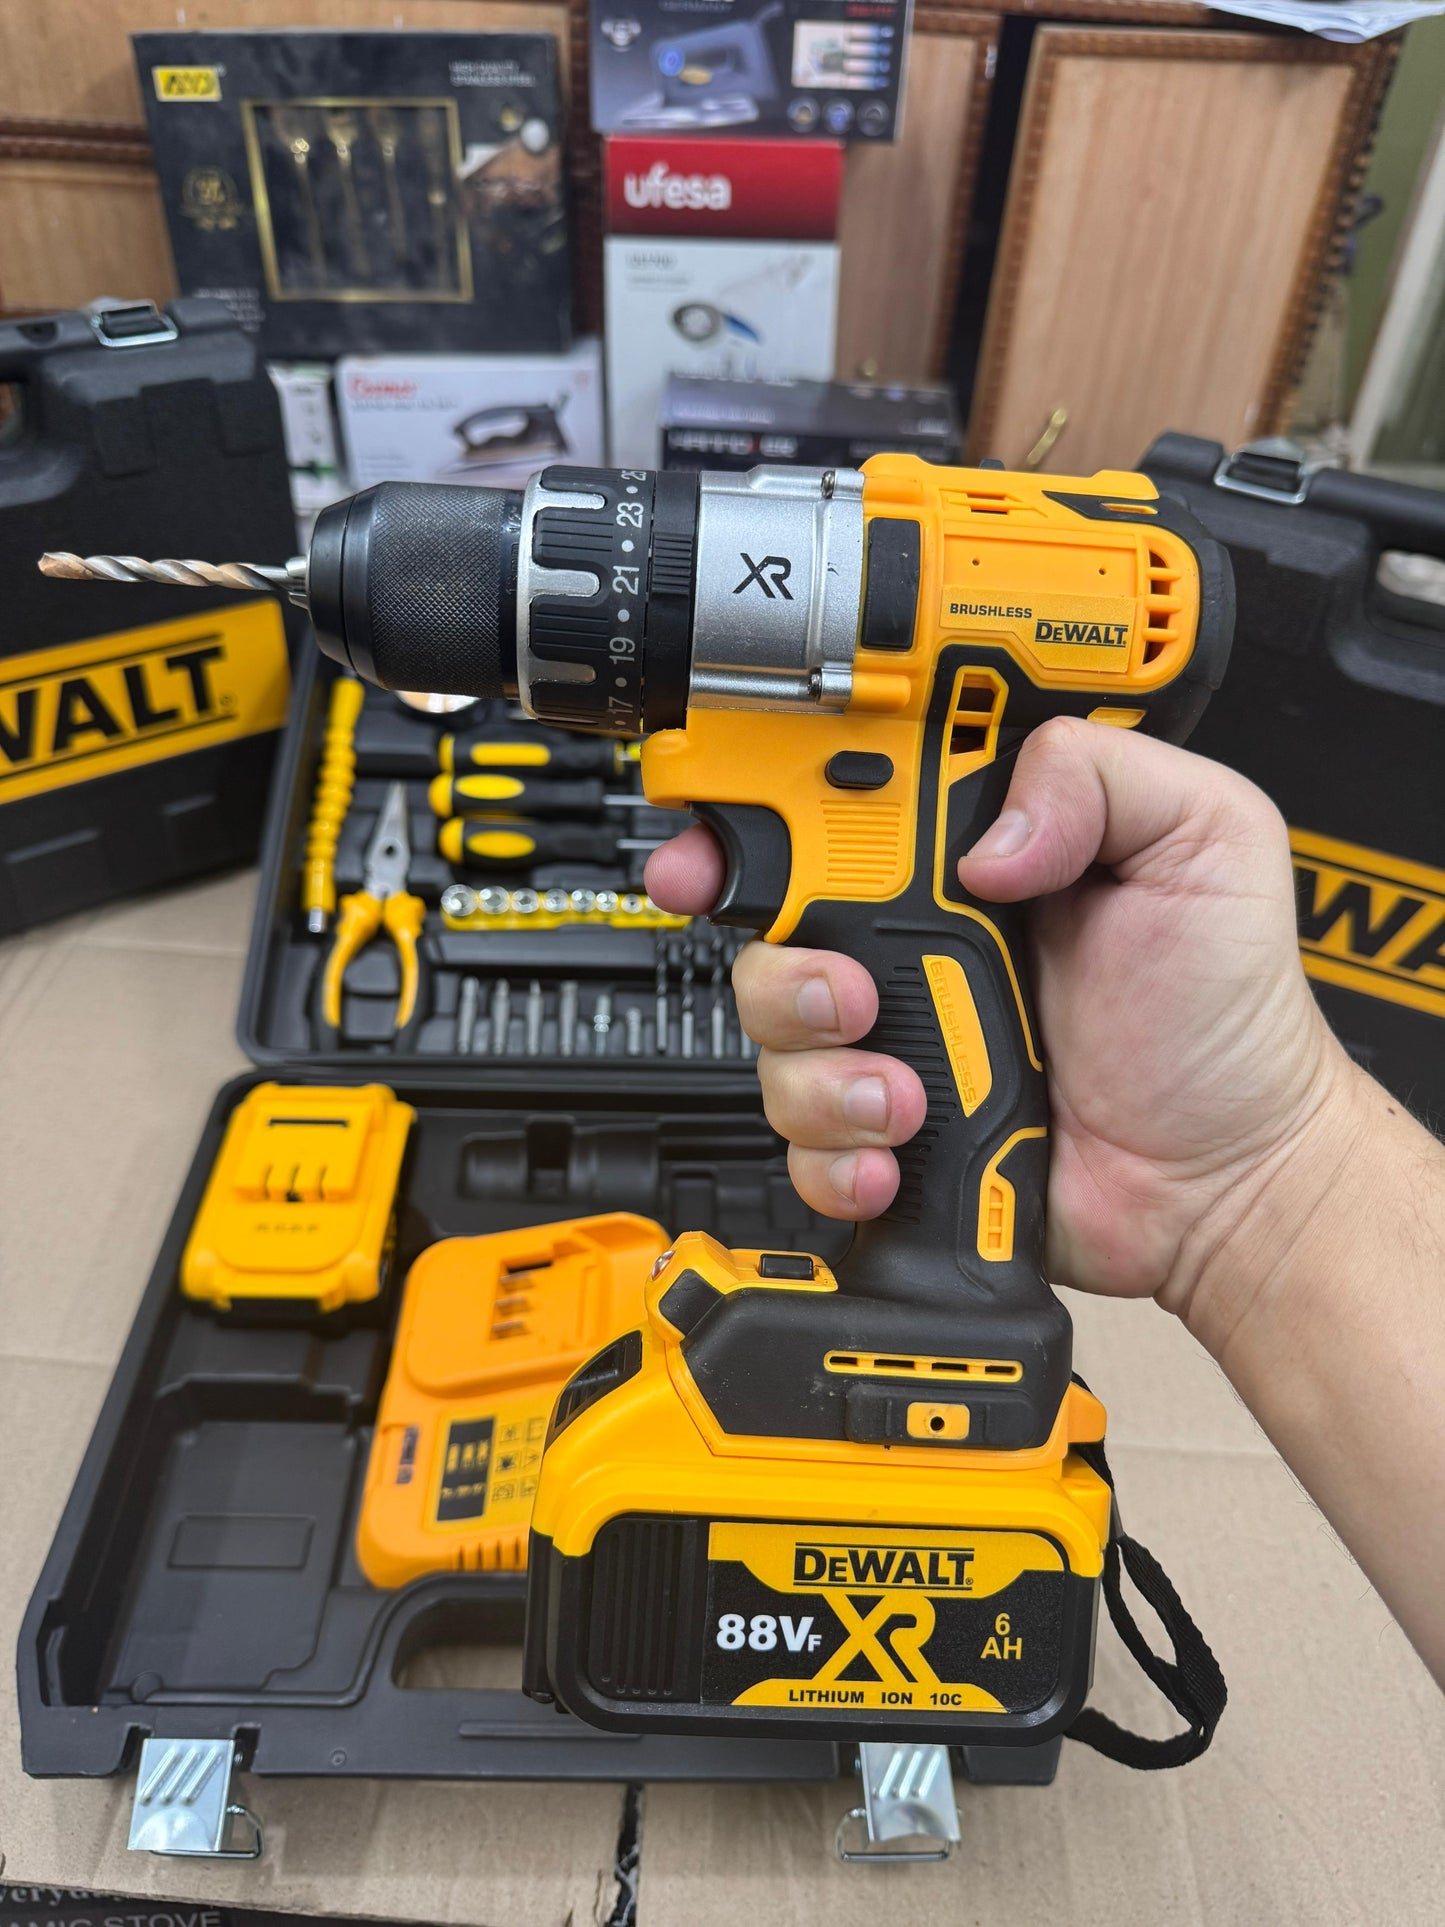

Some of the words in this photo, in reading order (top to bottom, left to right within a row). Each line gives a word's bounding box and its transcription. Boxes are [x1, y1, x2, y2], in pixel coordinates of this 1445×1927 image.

[624, 161, 732, 210] ufesa
[616, 502, 644, 528] 23
[612, 565, 640, 595] 21
[732, 552, 794, 601] XR
[950, 603, 1032, 619] BRUSHLESS
[609, 637, 635, 665] 19
[609, 696, 634, 714] 17
[929, 960, 977, 1104] BRUSHLESS
[812, 1593, 942, 1683] XR
[994, 1613, 1010, 1636] 6
[980, 1637, 1022, 1660] AH
[788, 1689, 865, 1704] LITHIUM
[881, 1691, 913, 1705] ION
[930, 1693, 962, 1706] 10C
